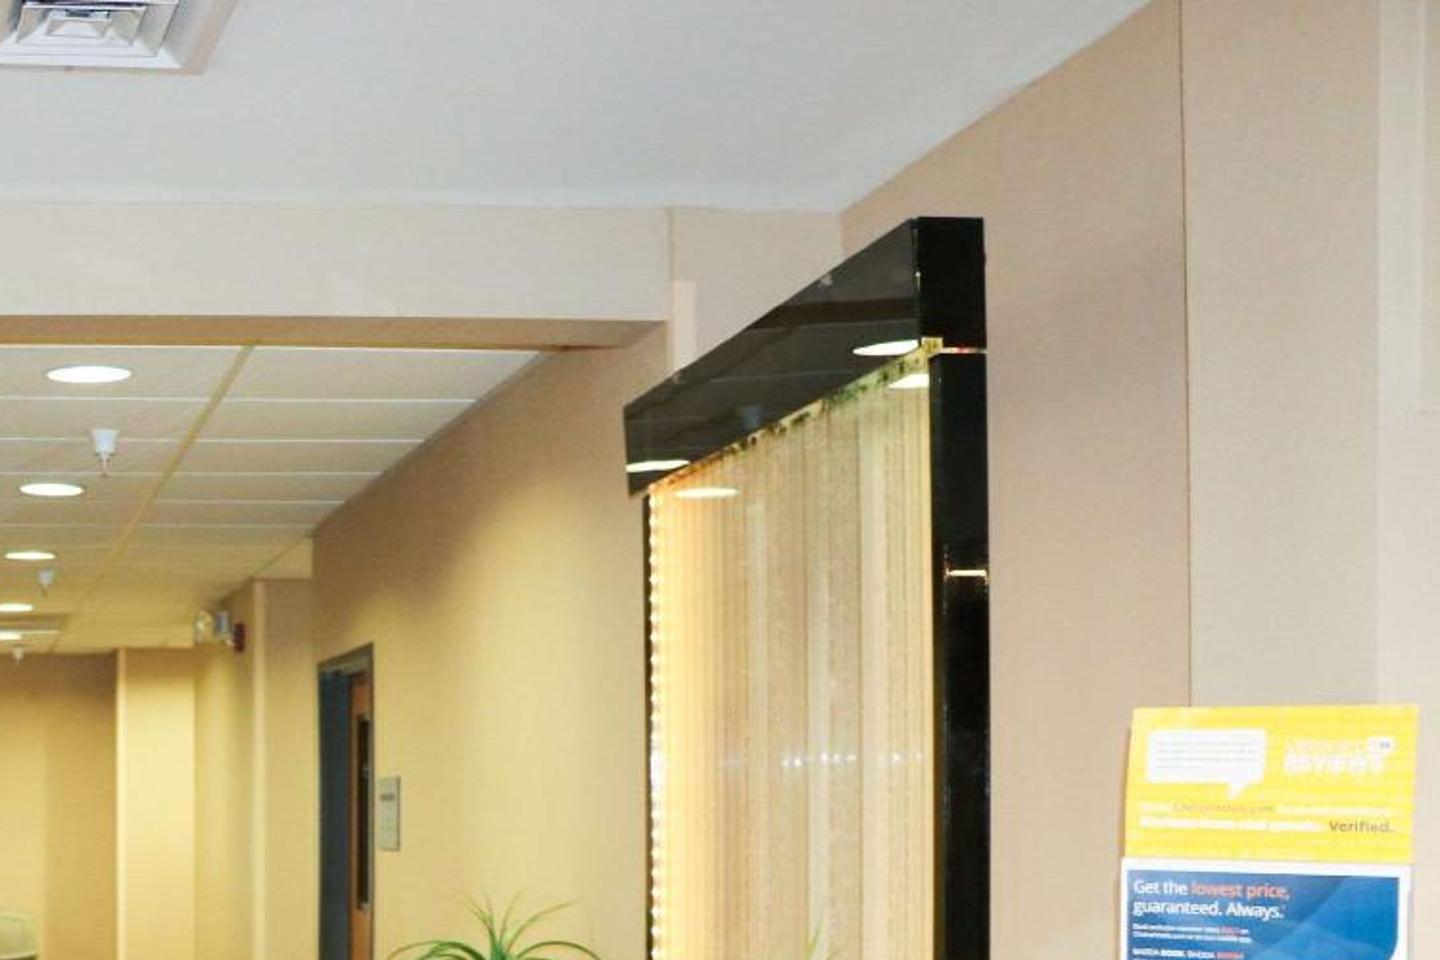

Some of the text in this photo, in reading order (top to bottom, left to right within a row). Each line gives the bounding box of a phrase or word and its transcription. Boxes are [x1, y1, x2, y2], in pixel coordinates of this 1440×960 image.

[1134, 879, 1159, 894] Get
[1163, 879, 1188, 895] the
[1190, 880, 1243, 898] lowest
[1132, 899, 1222, 917] guaranteed.
